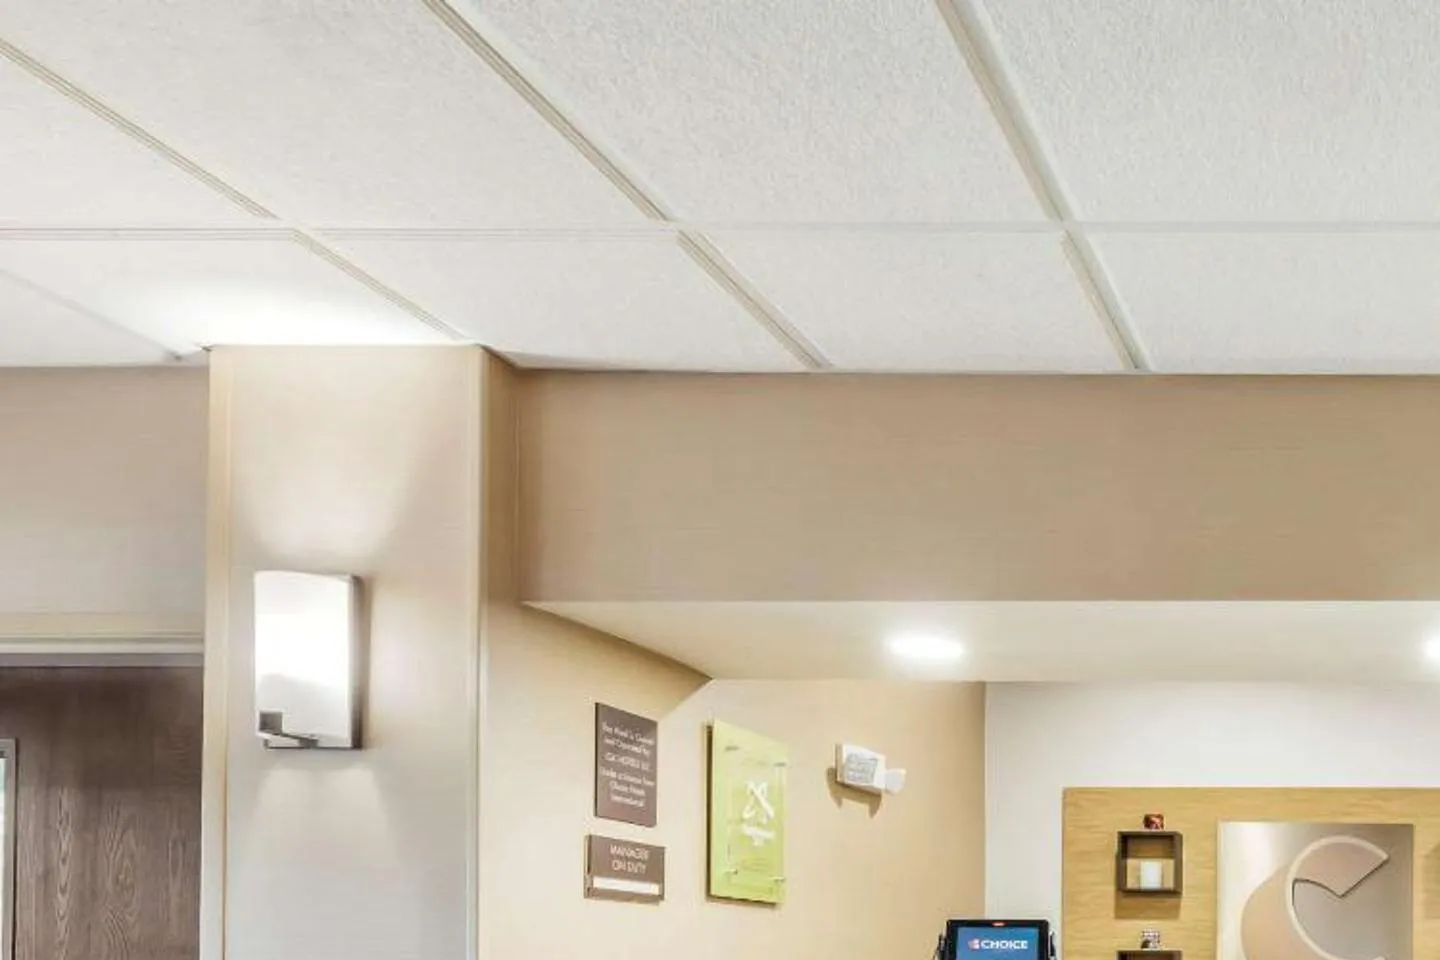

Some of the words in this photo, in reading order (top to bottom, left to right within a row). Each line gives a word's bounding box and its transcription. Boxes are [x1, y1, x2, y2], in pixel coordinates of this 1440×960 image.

[609, 843, 649, 861] MANAGER
[611, 859, 626, 871] ON
[627, 860, 646, 874] DUTY
[981, 939, 1028, 950] CHOICE
